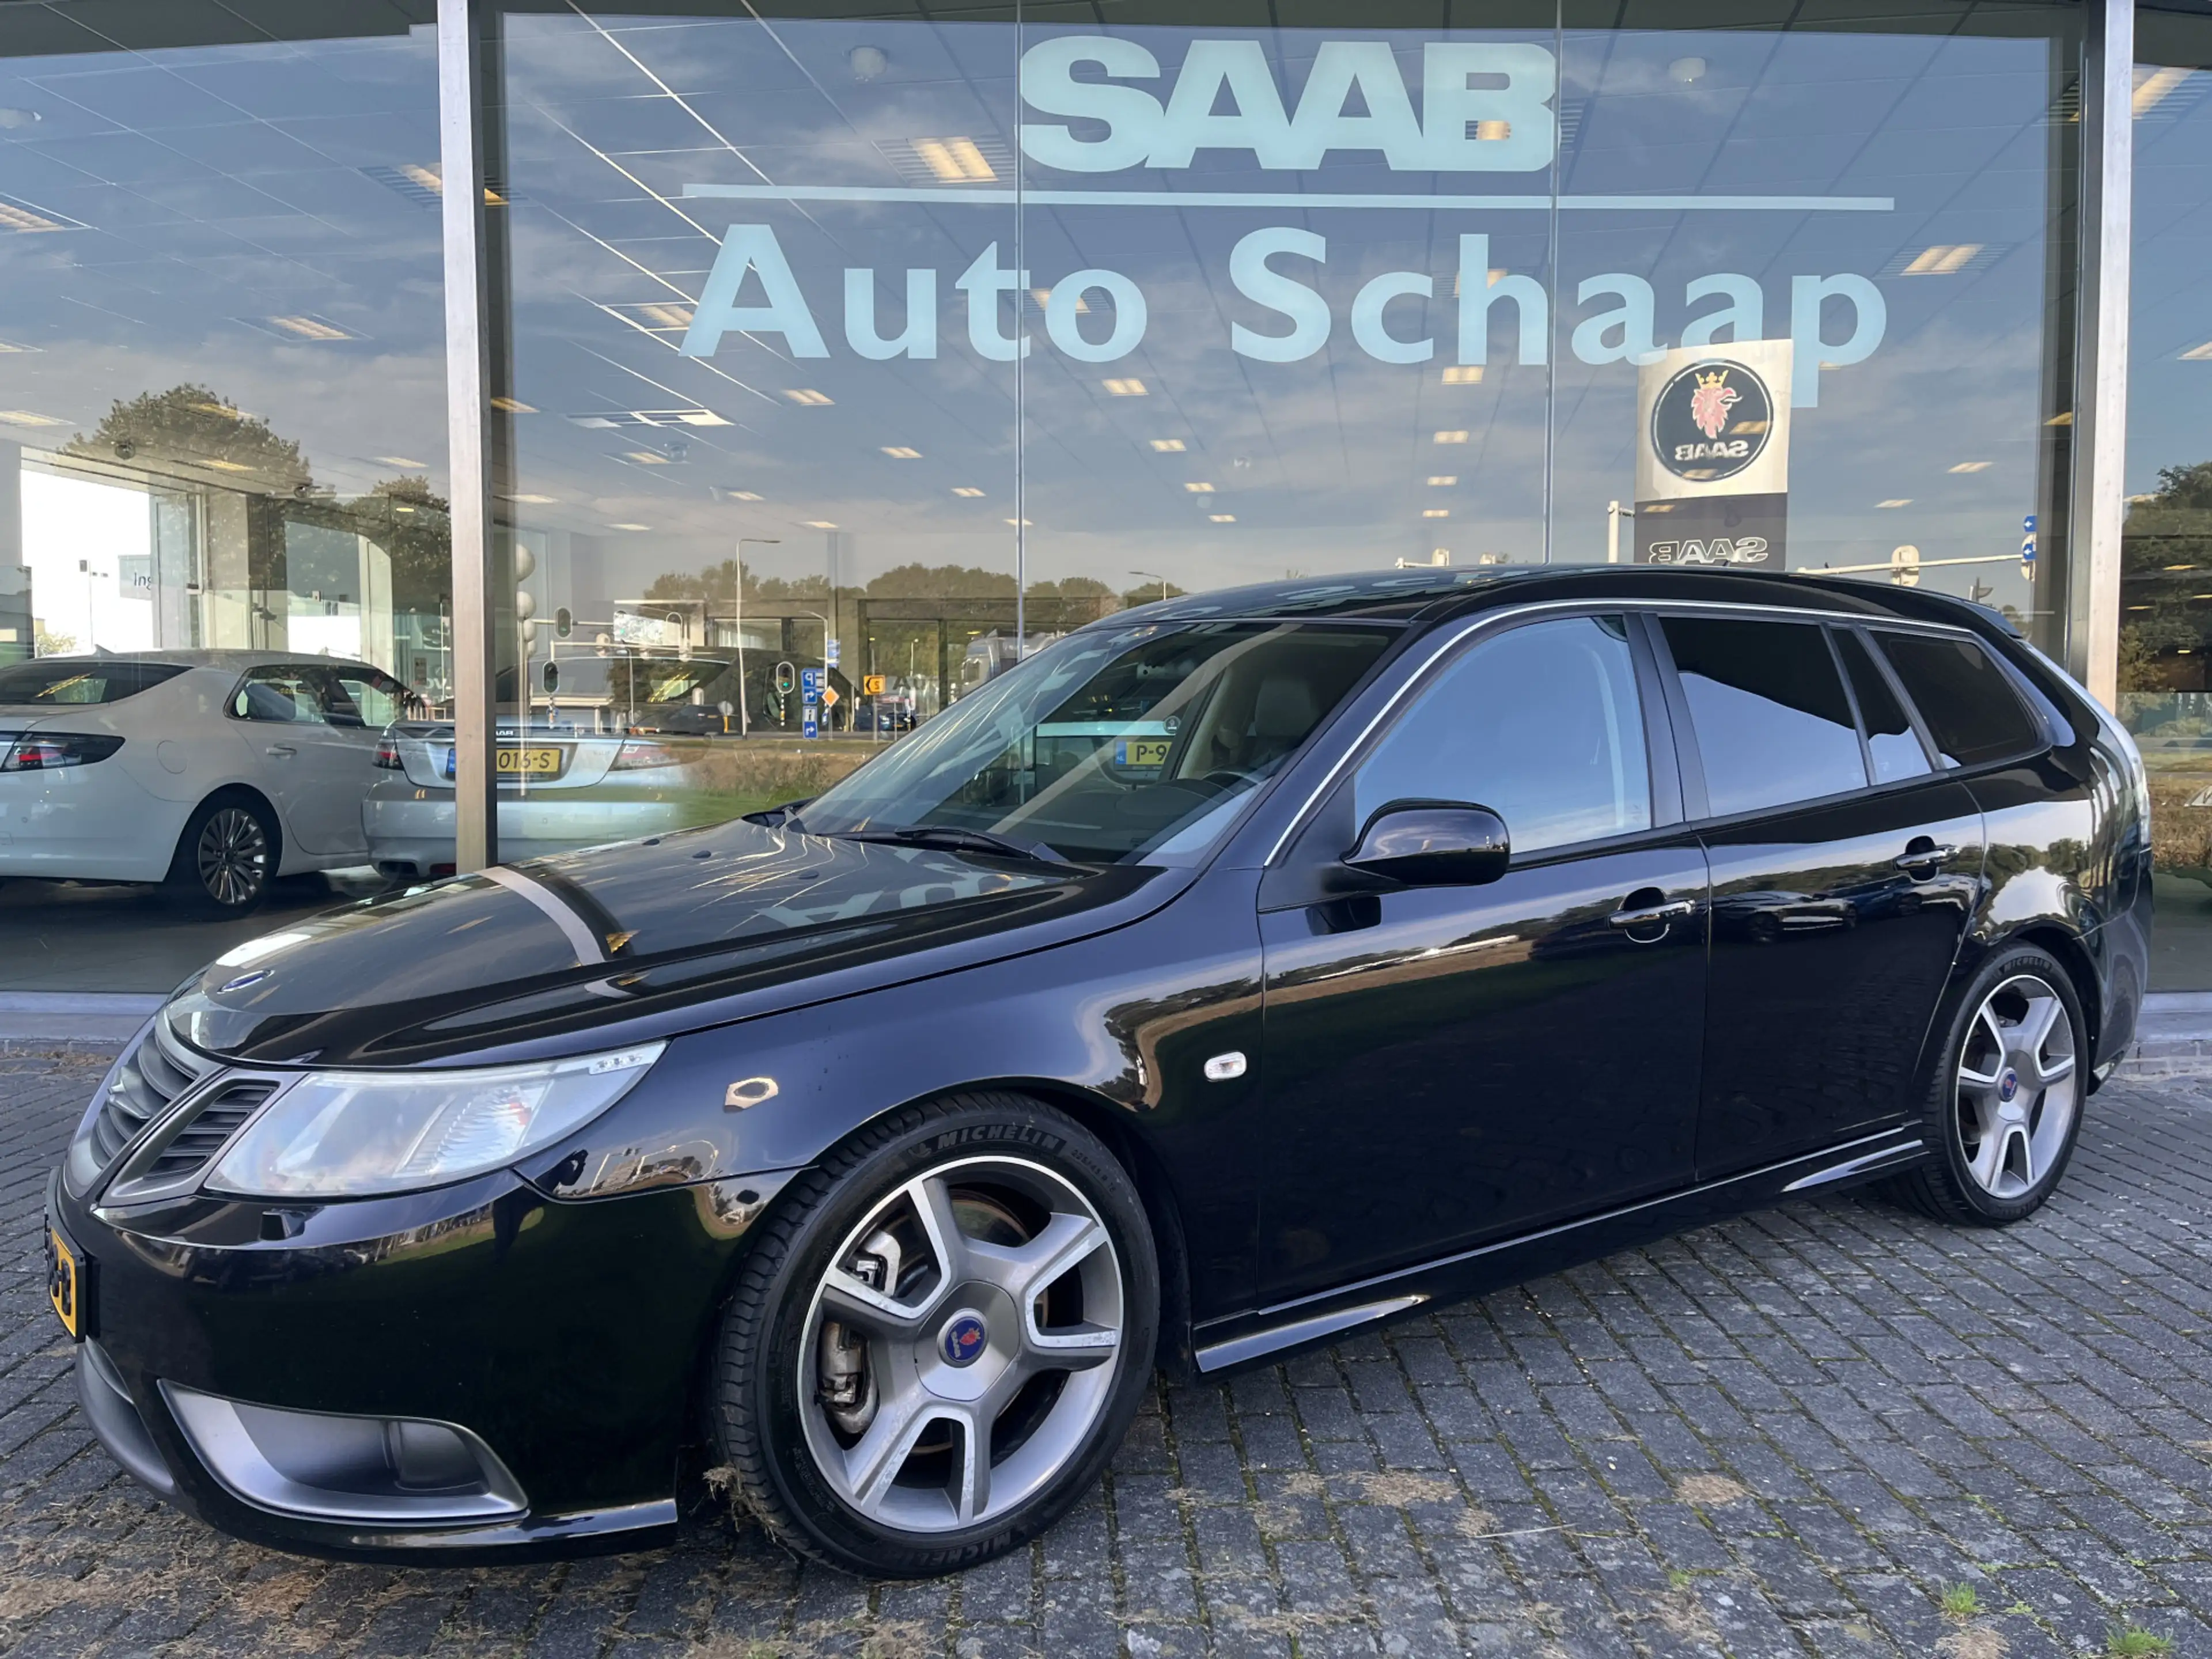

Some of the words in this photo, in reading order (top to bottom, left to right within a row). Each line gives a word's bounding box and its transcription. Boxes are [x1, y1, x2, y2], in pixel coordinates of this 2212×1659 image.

[1017, 36, 1556, 172] SAAB
[681, 224, 1147, 364] Auto
[1229, 226, 1888, 408] Schaap
[937, 1123, 1060, 1152] MICHELIN
